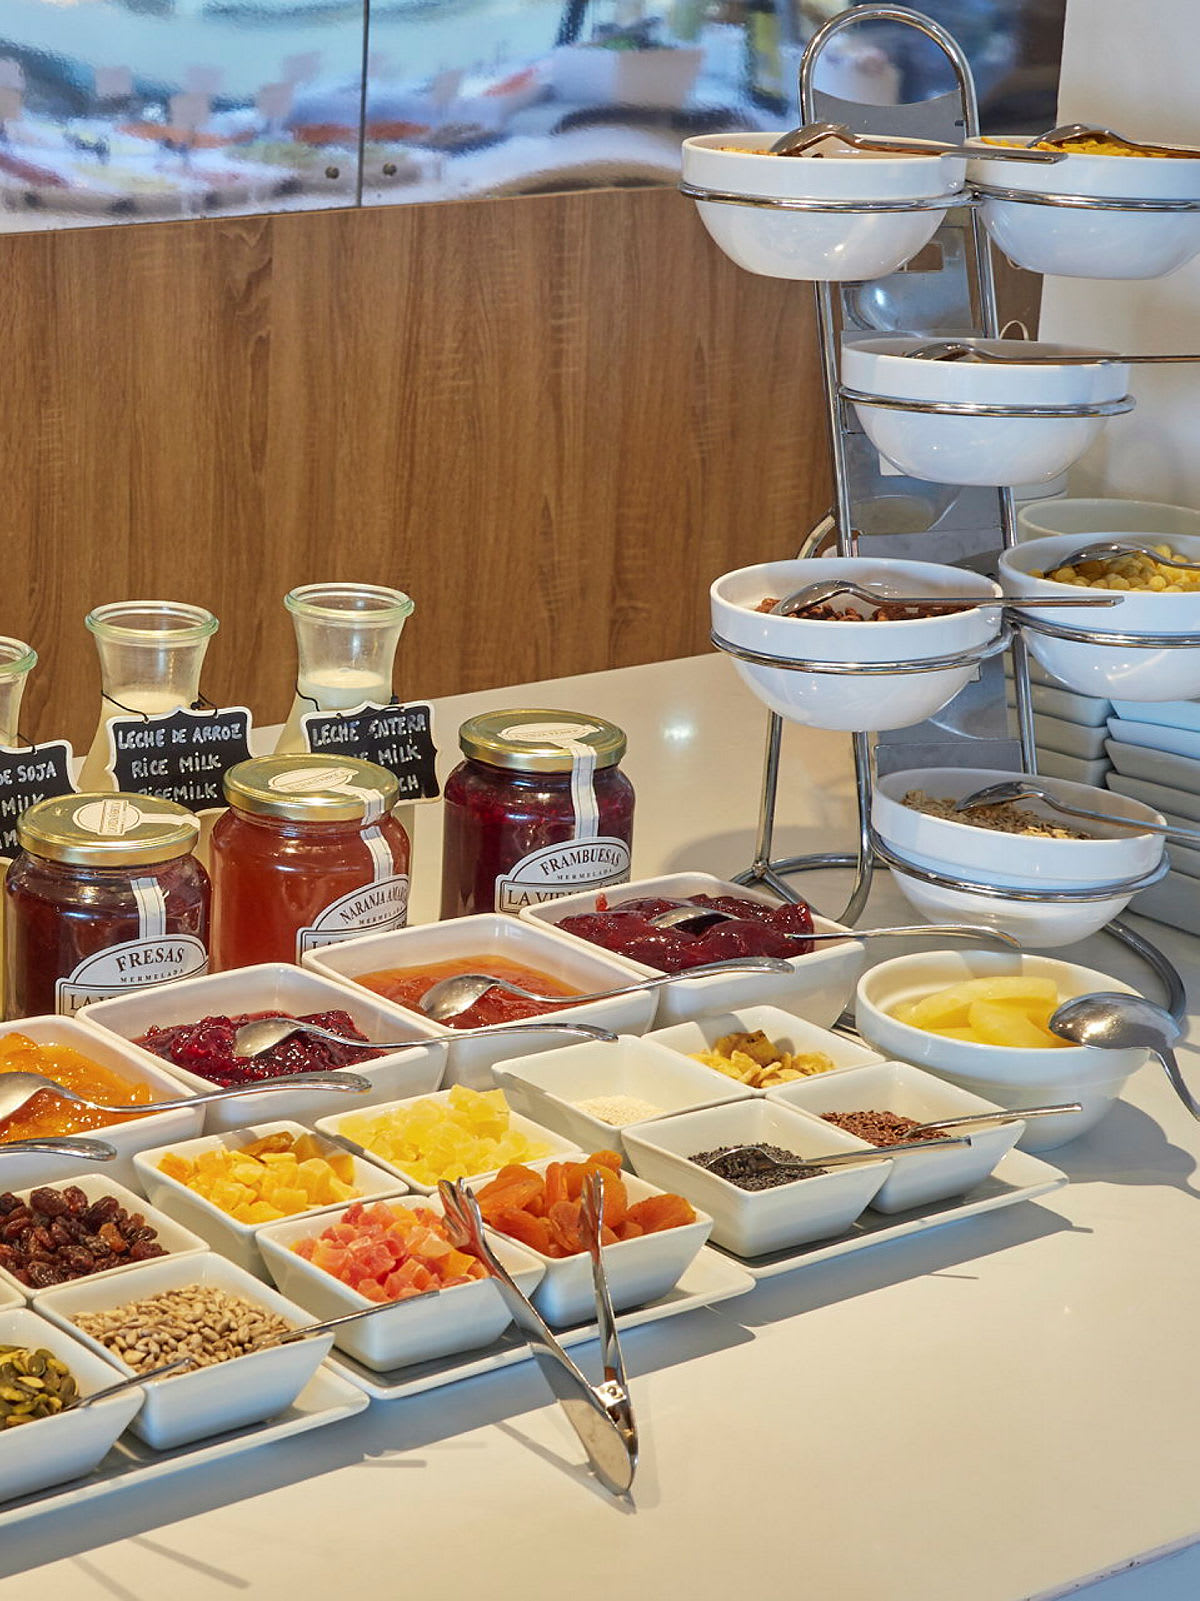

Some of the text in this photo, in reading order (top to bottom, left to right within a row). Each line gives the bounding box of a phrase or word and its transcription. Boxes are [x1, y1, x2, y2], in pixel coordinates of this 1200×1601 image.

[117, 722, 243, 749] LECHE DE ARROZ
[312, 713, 427, 747] LECHE ENTERA
[17, 760, 57, 783] SOJA
[540, 848, 622, 876] FRAMBUESAS
[339, 890, 385, 924] NARANJA
[507, 889, 531, 906] LA
[116, 947, 185, 973] FRESAS
[120, 968, 184, 984] MERMELADA
